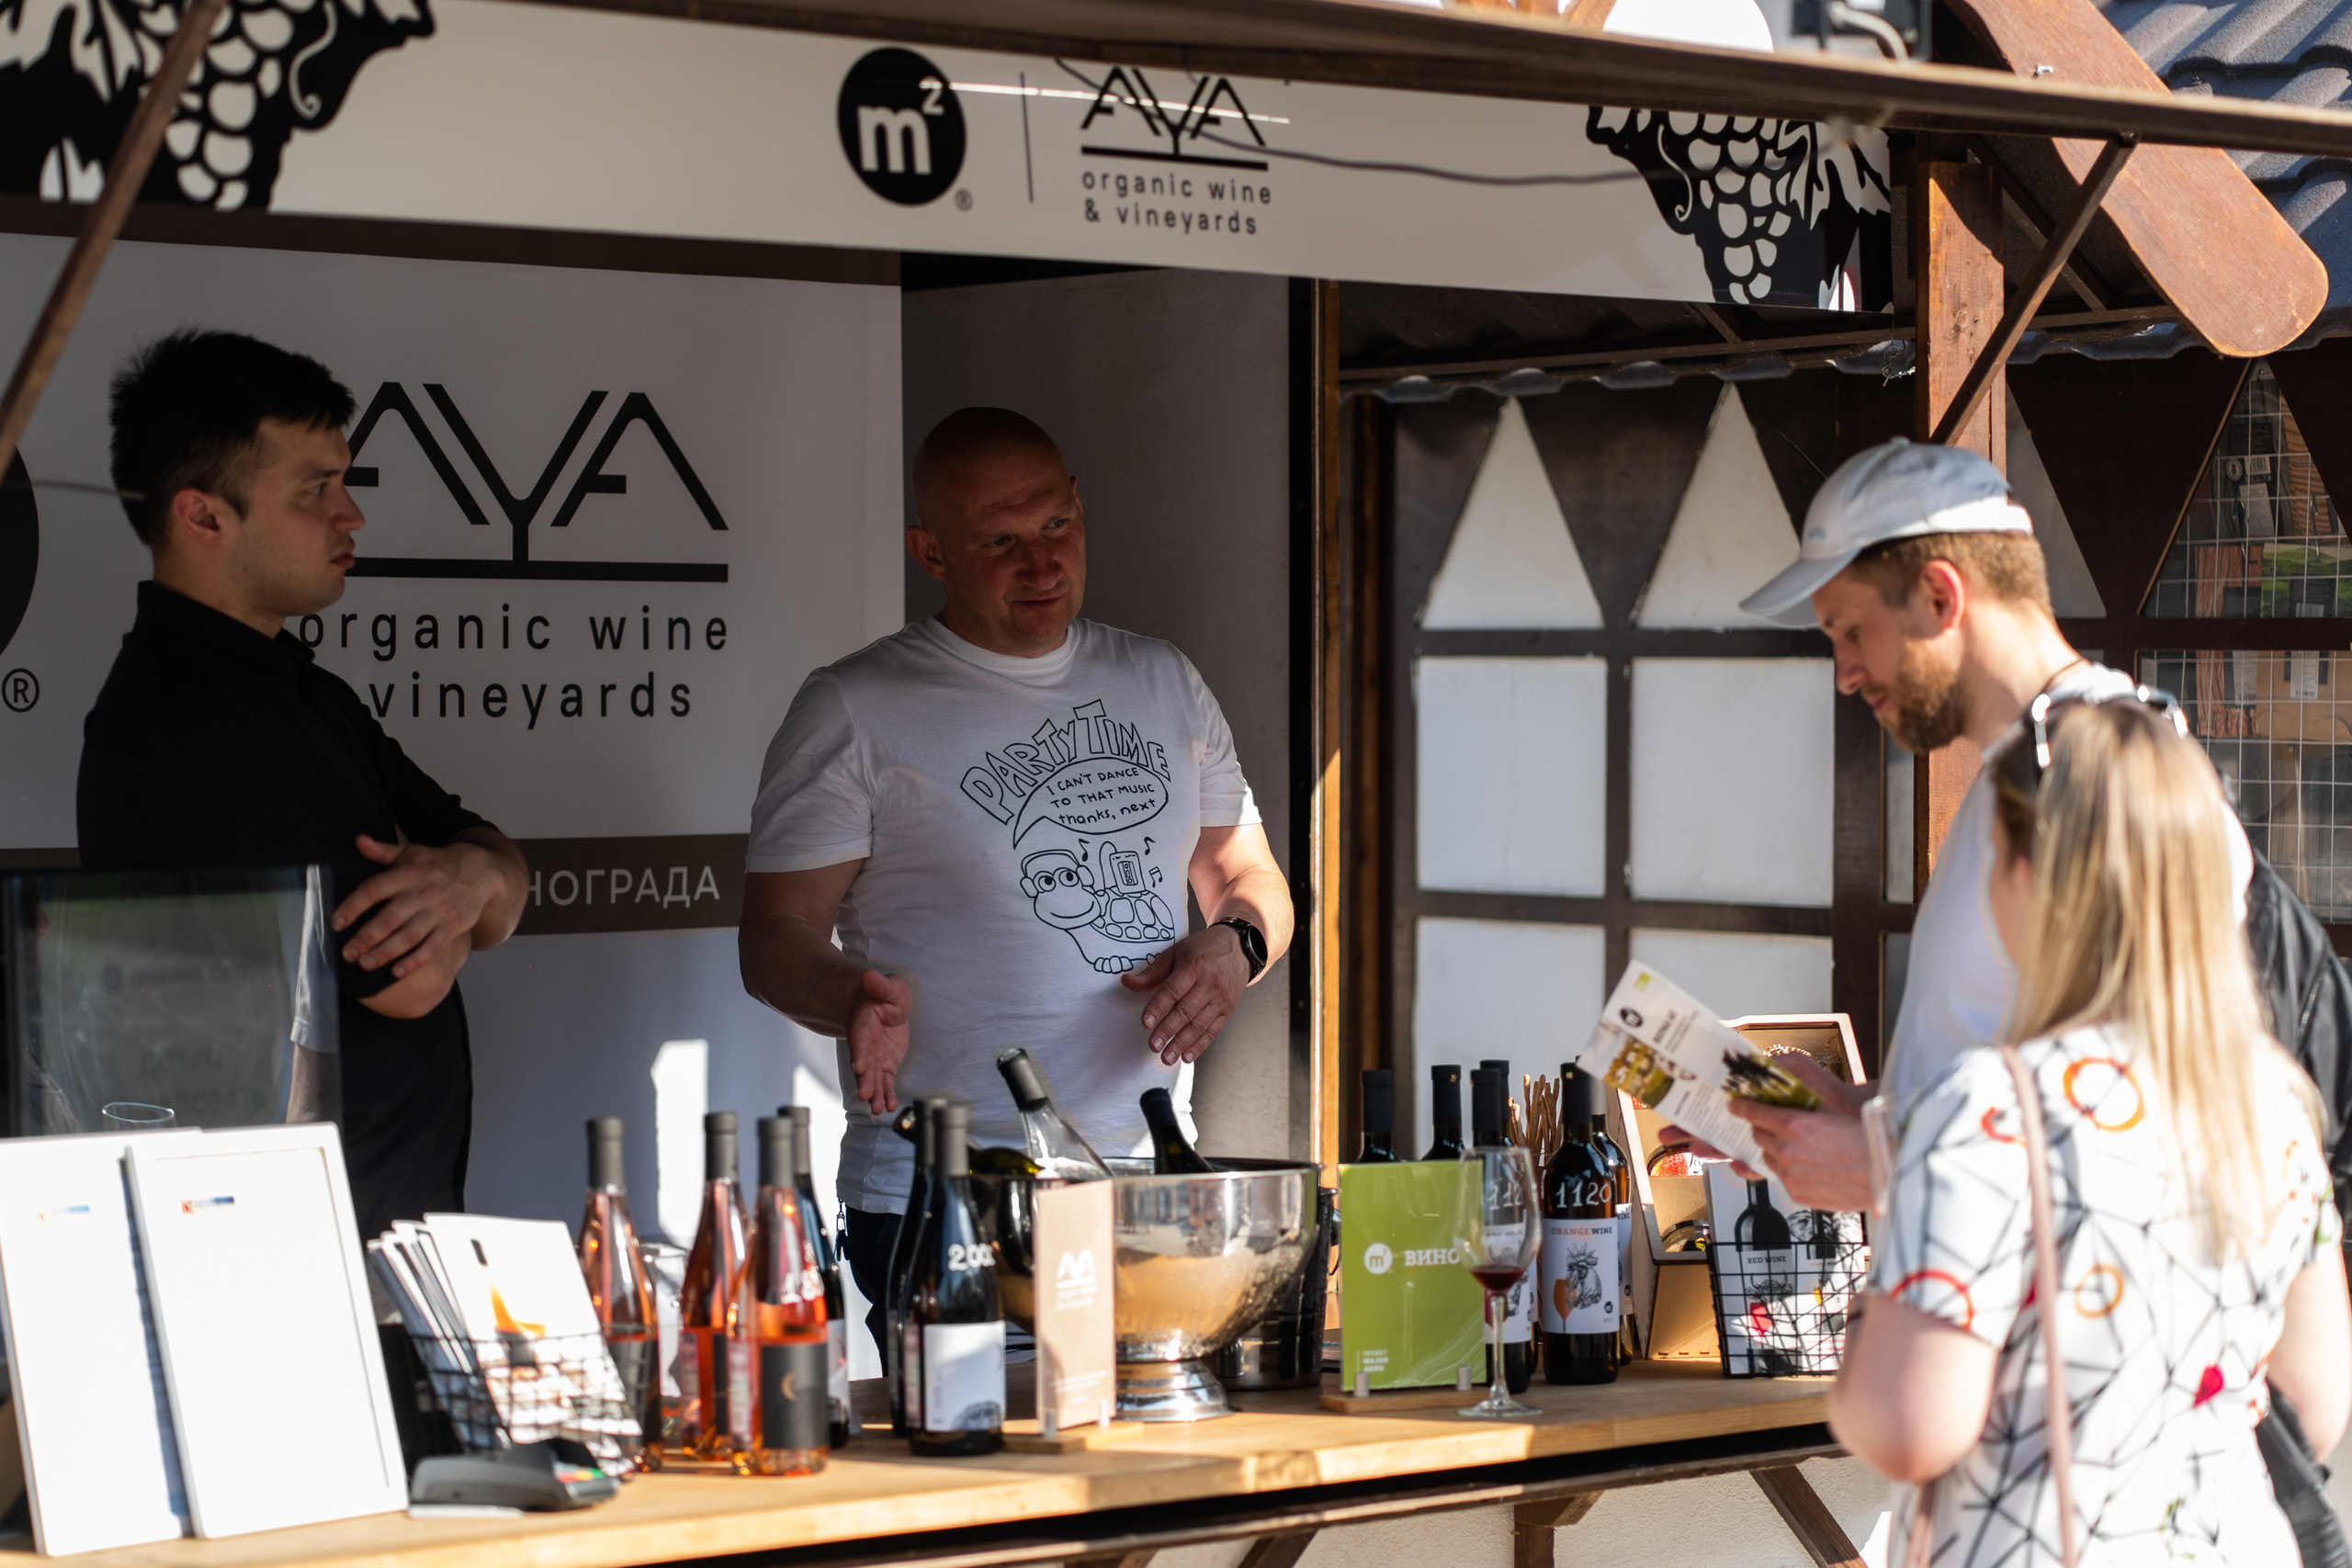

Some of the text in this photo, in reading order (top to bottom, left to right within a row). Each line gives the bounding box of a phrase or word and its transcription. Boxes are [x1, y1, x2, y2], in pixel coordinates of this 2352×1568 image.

[1082, 169, 1272, 204] organic wine
[1084, 198, 1257, 235] & vineyards
[299, 604, 728, 661] organic wine
[368, 671, 692, 730] vineyards
[1046, 767, 1139, 796] I CAN'T DANCE
[1050, 784, 1155, 809] TO THAT MUSIC
[1058, 797, 1156, 825] thanks, next
[1554, 1181, 1612, 1209] 1120
[1551, 1226, 1612, 1235] ORANGE WINE
[1405, 1247, 1461, 1267] ВИНО
[1765, 1256, 1787, 1264] WINE
